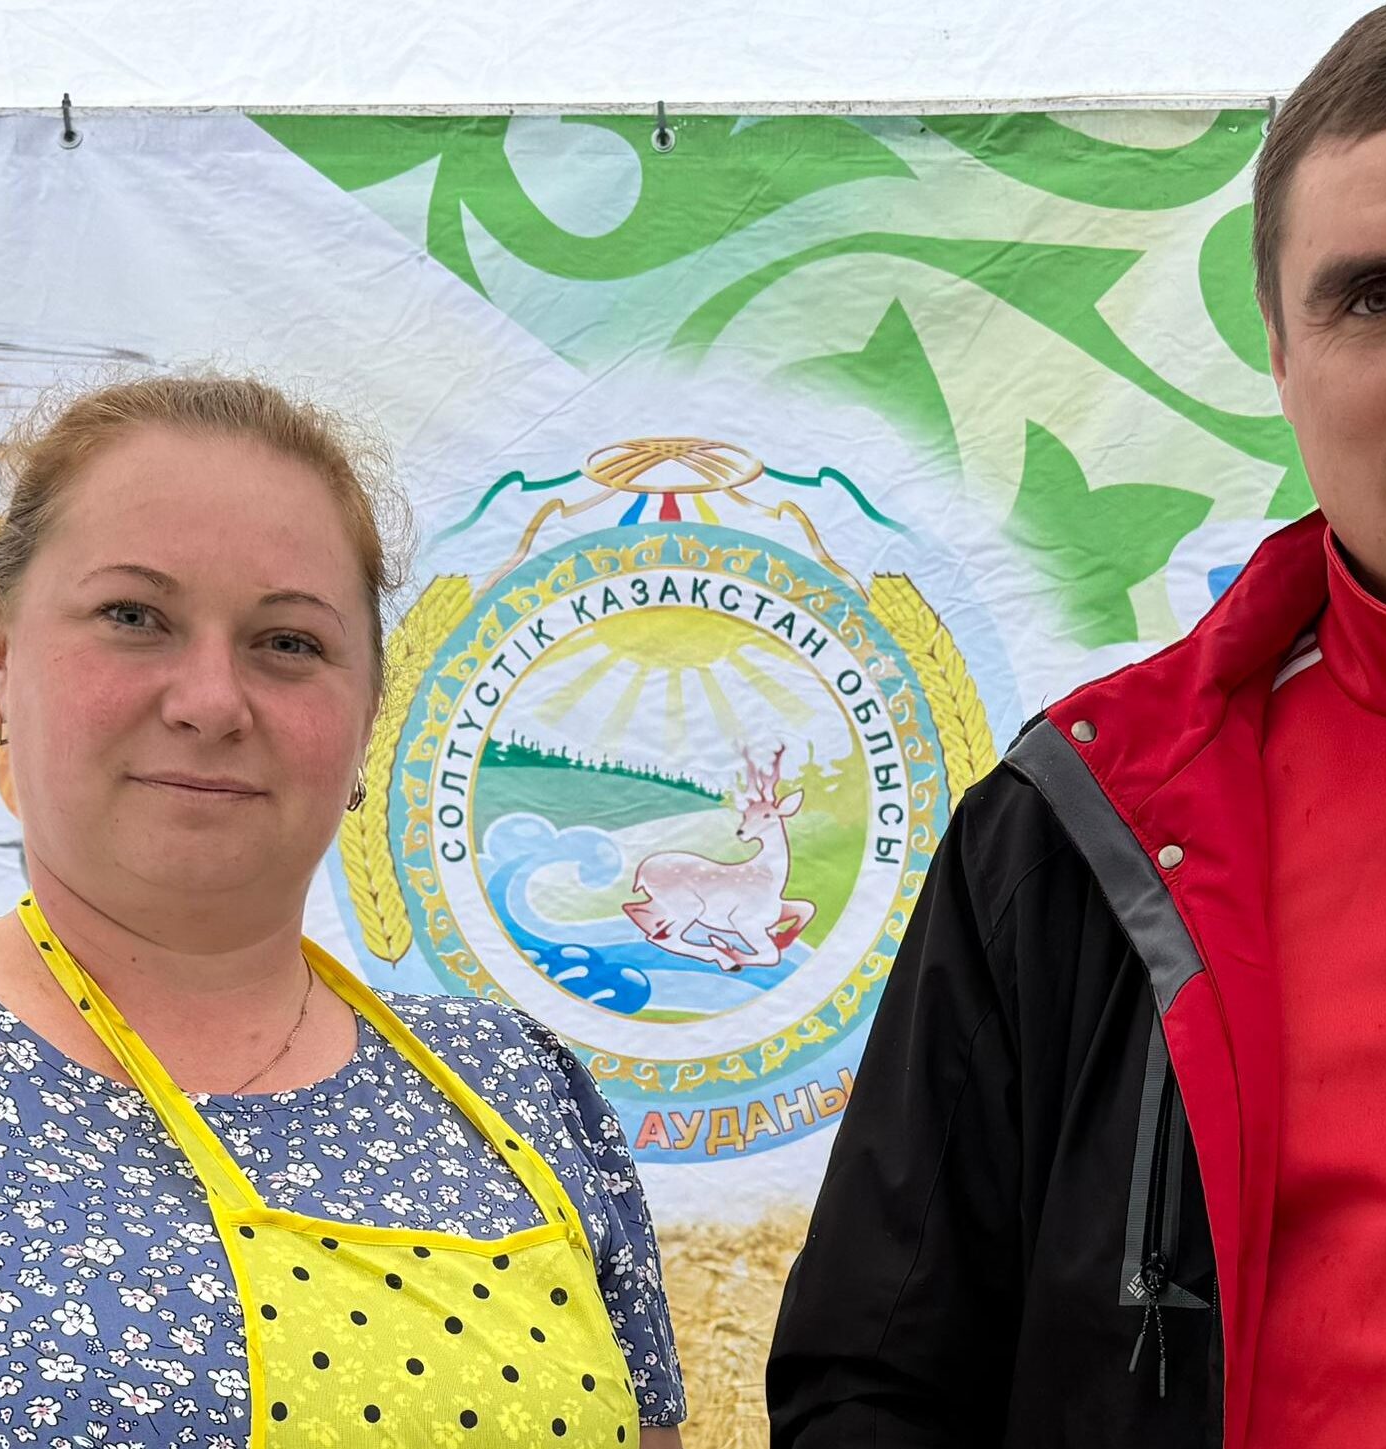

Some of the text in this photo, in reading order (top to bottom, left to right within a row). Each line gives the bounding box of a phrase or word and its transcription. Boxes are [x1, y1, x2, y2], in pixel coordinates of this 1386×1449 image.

[570, 575, 830, 660] ҚАЗАҚСТАН
[836, 668, 904, 865] ОБЛЫСЫ
[634, 1067, 853, 1157] АУДАНЫ
